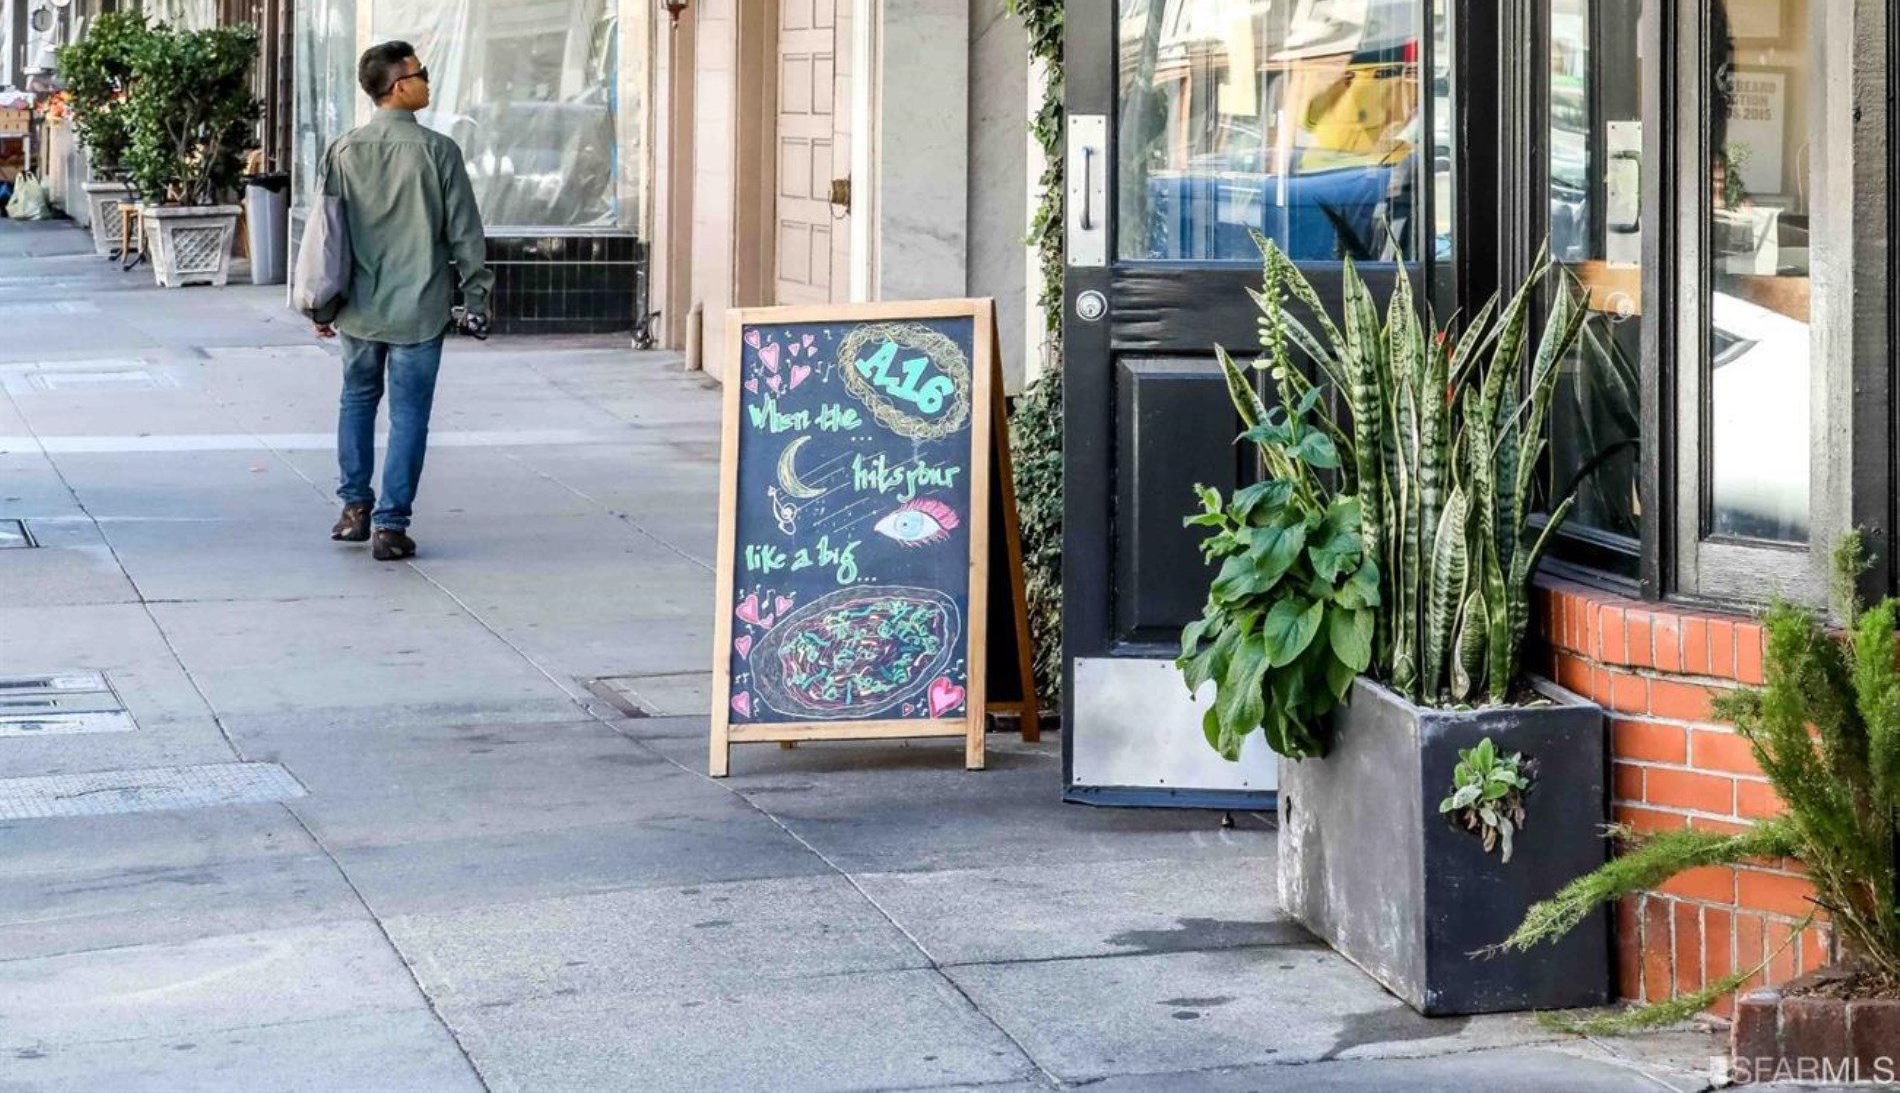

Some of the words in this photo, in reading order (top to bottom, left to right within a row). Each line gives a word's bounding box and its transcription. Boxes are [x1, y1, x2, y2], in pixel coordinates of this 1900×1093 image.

[1743, 108, 1772, 121] 2015
[855, 338, 955, 413] A16
[748, 392, 812, 434] When
[851, 452, 905, 494] hits
[897, 459, 961, 503] your
[745, 544, 787, 574] like
[790, 548, 814, 572] a
